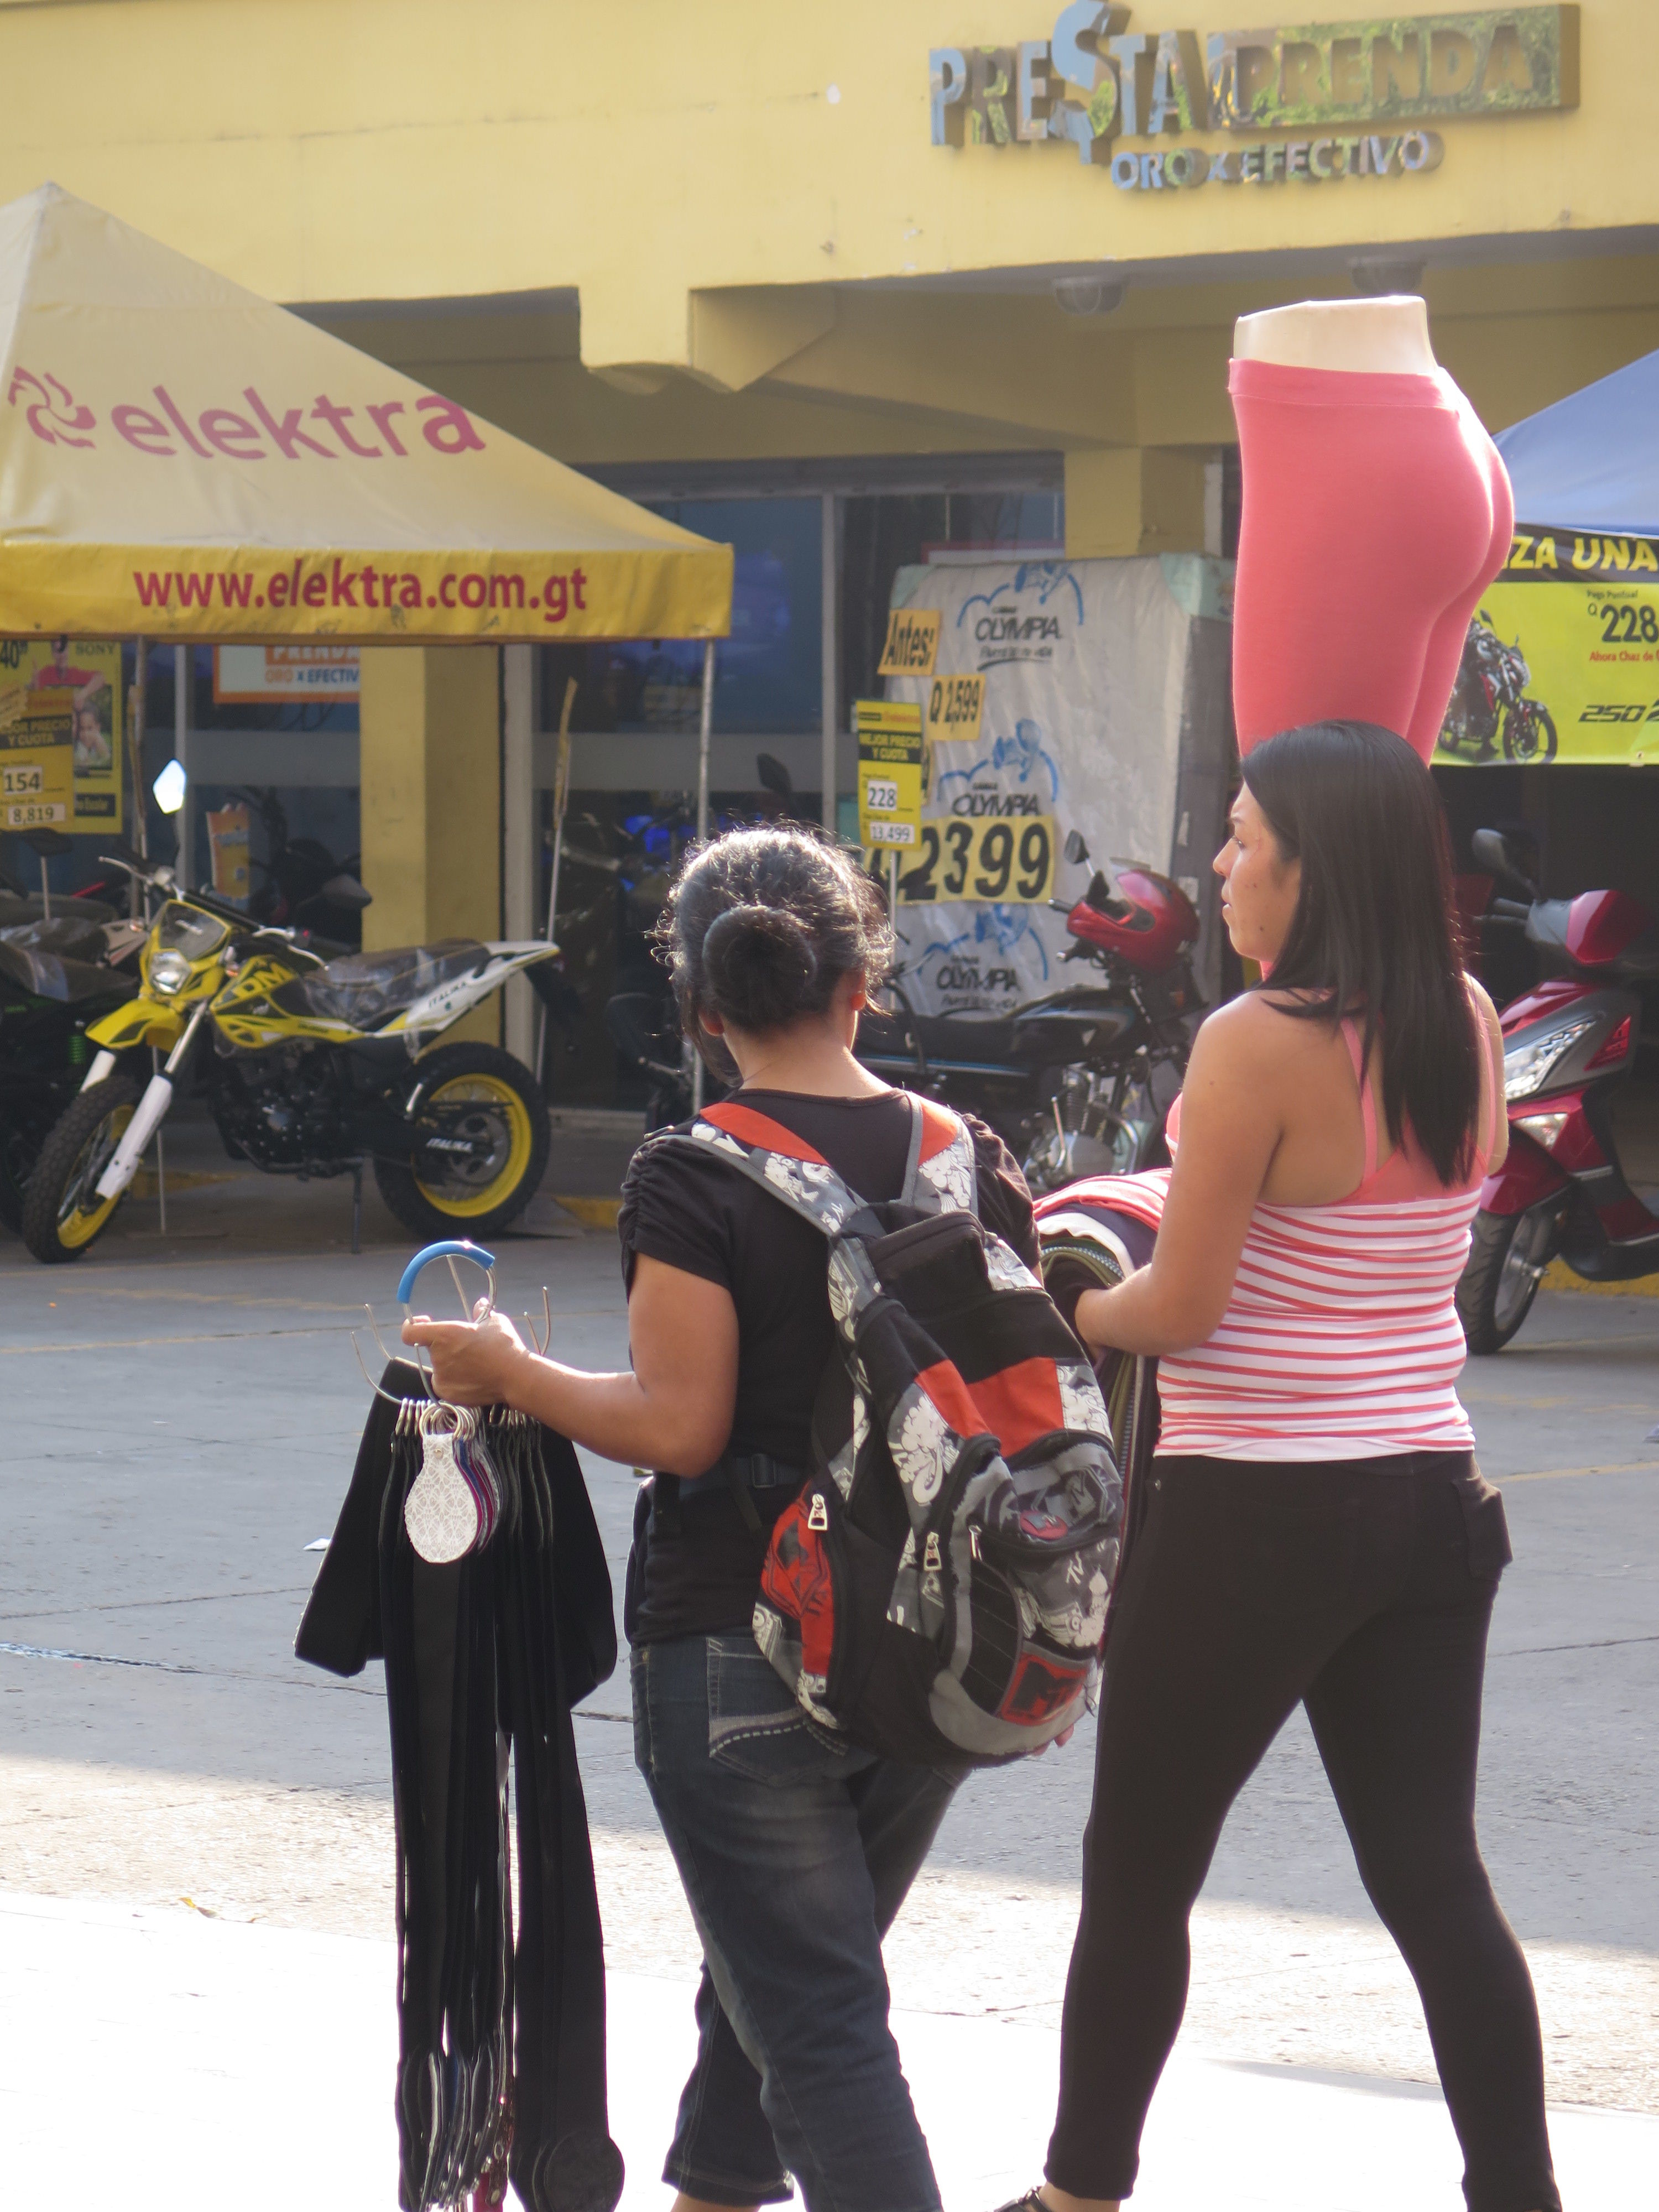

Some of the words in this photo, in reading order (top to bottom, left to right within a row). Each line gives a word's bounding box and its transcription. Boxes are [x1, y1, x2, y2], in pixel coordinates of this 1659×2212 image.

[1111, 148, 1193, 190] ORO
[1240, 131, 1433, 182] EFECTIVO
[111, 385, 486, 460] elektra
[1502, 535, 1558, 570] ZA
[1572, 537, 1659, 572] UNA
[133, 558, 588, 623] www.elektra.com.gt
[974, 616, 1062, 642] OLYMPIA
[1588, 603, 1598, 616] Q
[1600, 604, 1659, 643] 228
[1578, 705, 1647, 722] 250
[6, 773, 40, 792] 154
[869, 787, 896, 808] 228
[952, 794, 1041, 817] OLYMPIA
[13, 806, 54, 826] 8,819
